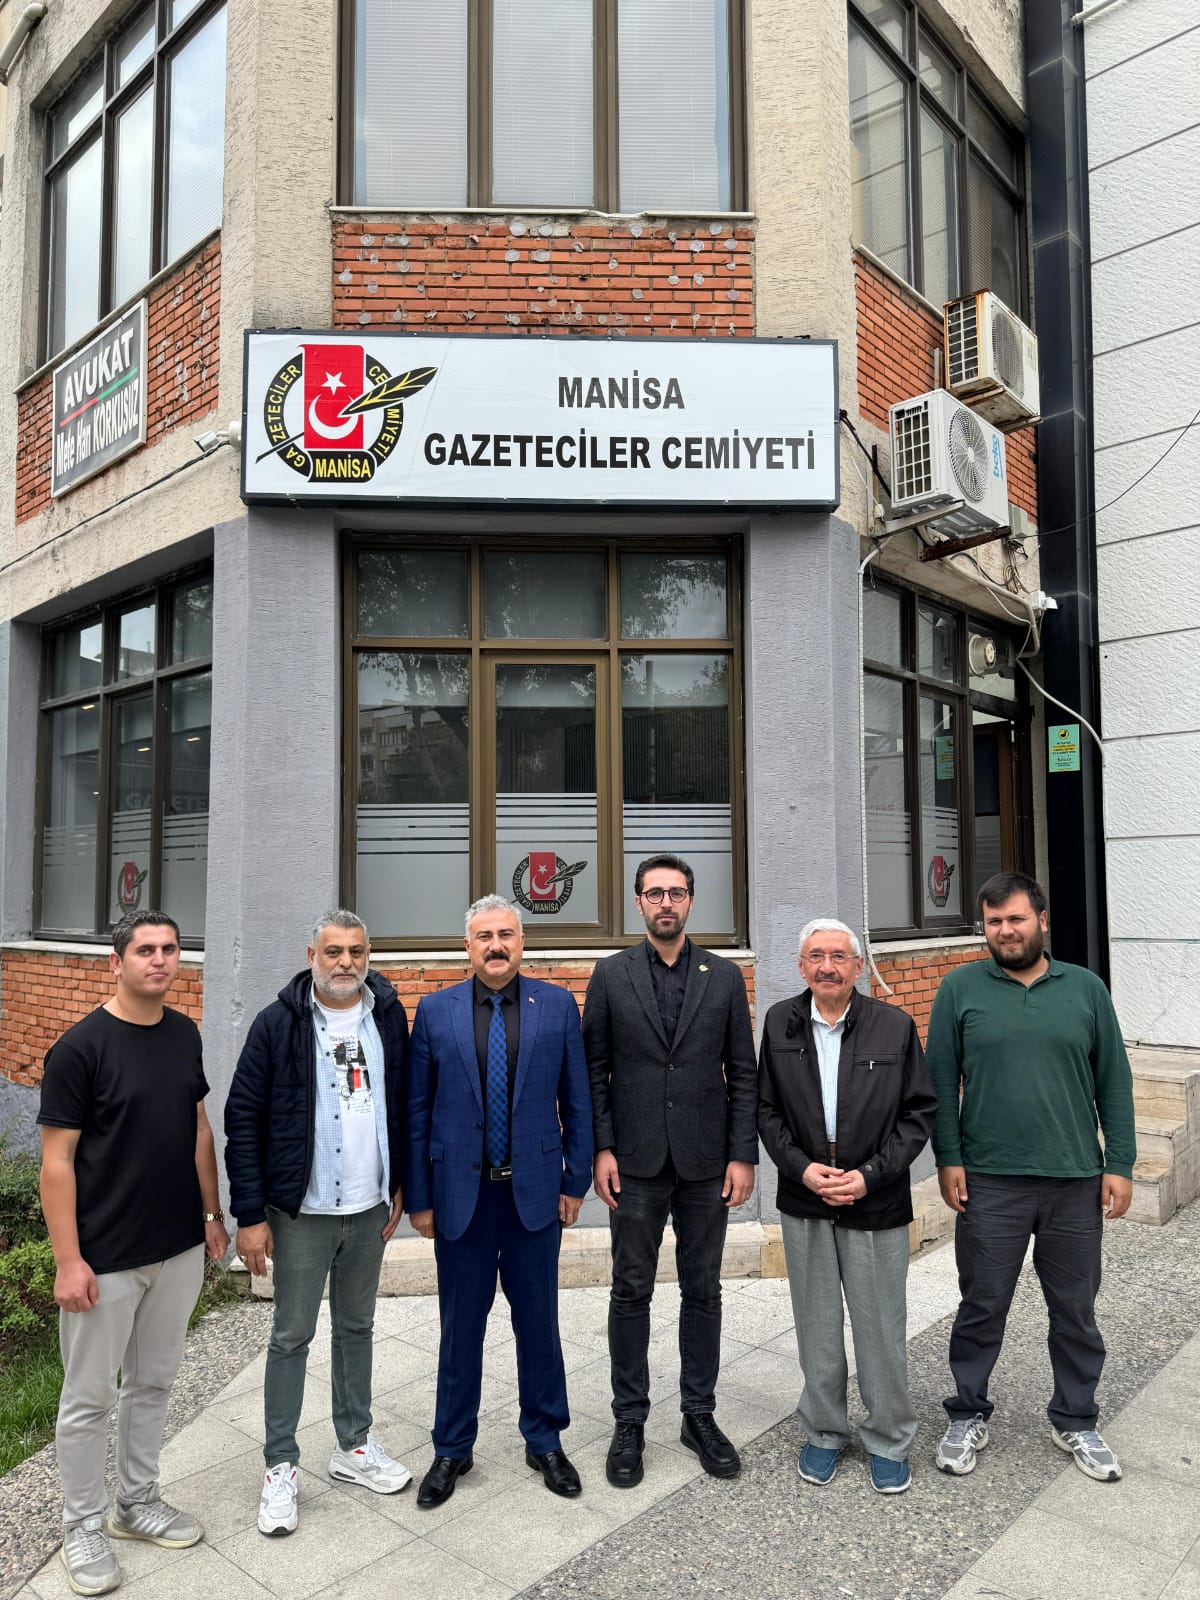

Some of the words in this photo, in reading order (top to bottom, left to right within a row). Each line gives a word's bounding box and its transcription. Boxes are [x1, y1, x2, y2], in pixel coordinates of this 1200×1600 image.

[64, 328, 134, 414] AVUKAT
[558, 369, 686, 410] MANİSA
[56, 429, 75, 477] Mete
[76, 418, 92, 464] Han
[93, 378, 140, 454] KORKUSUZ
[315, 454, 372, 478] MANİSA
[423, 428, 651, 469] GAZETECİLER
[661, 428, 815, 470] CEMİYETİ
[534, 901, 560, 912] MANİSA
